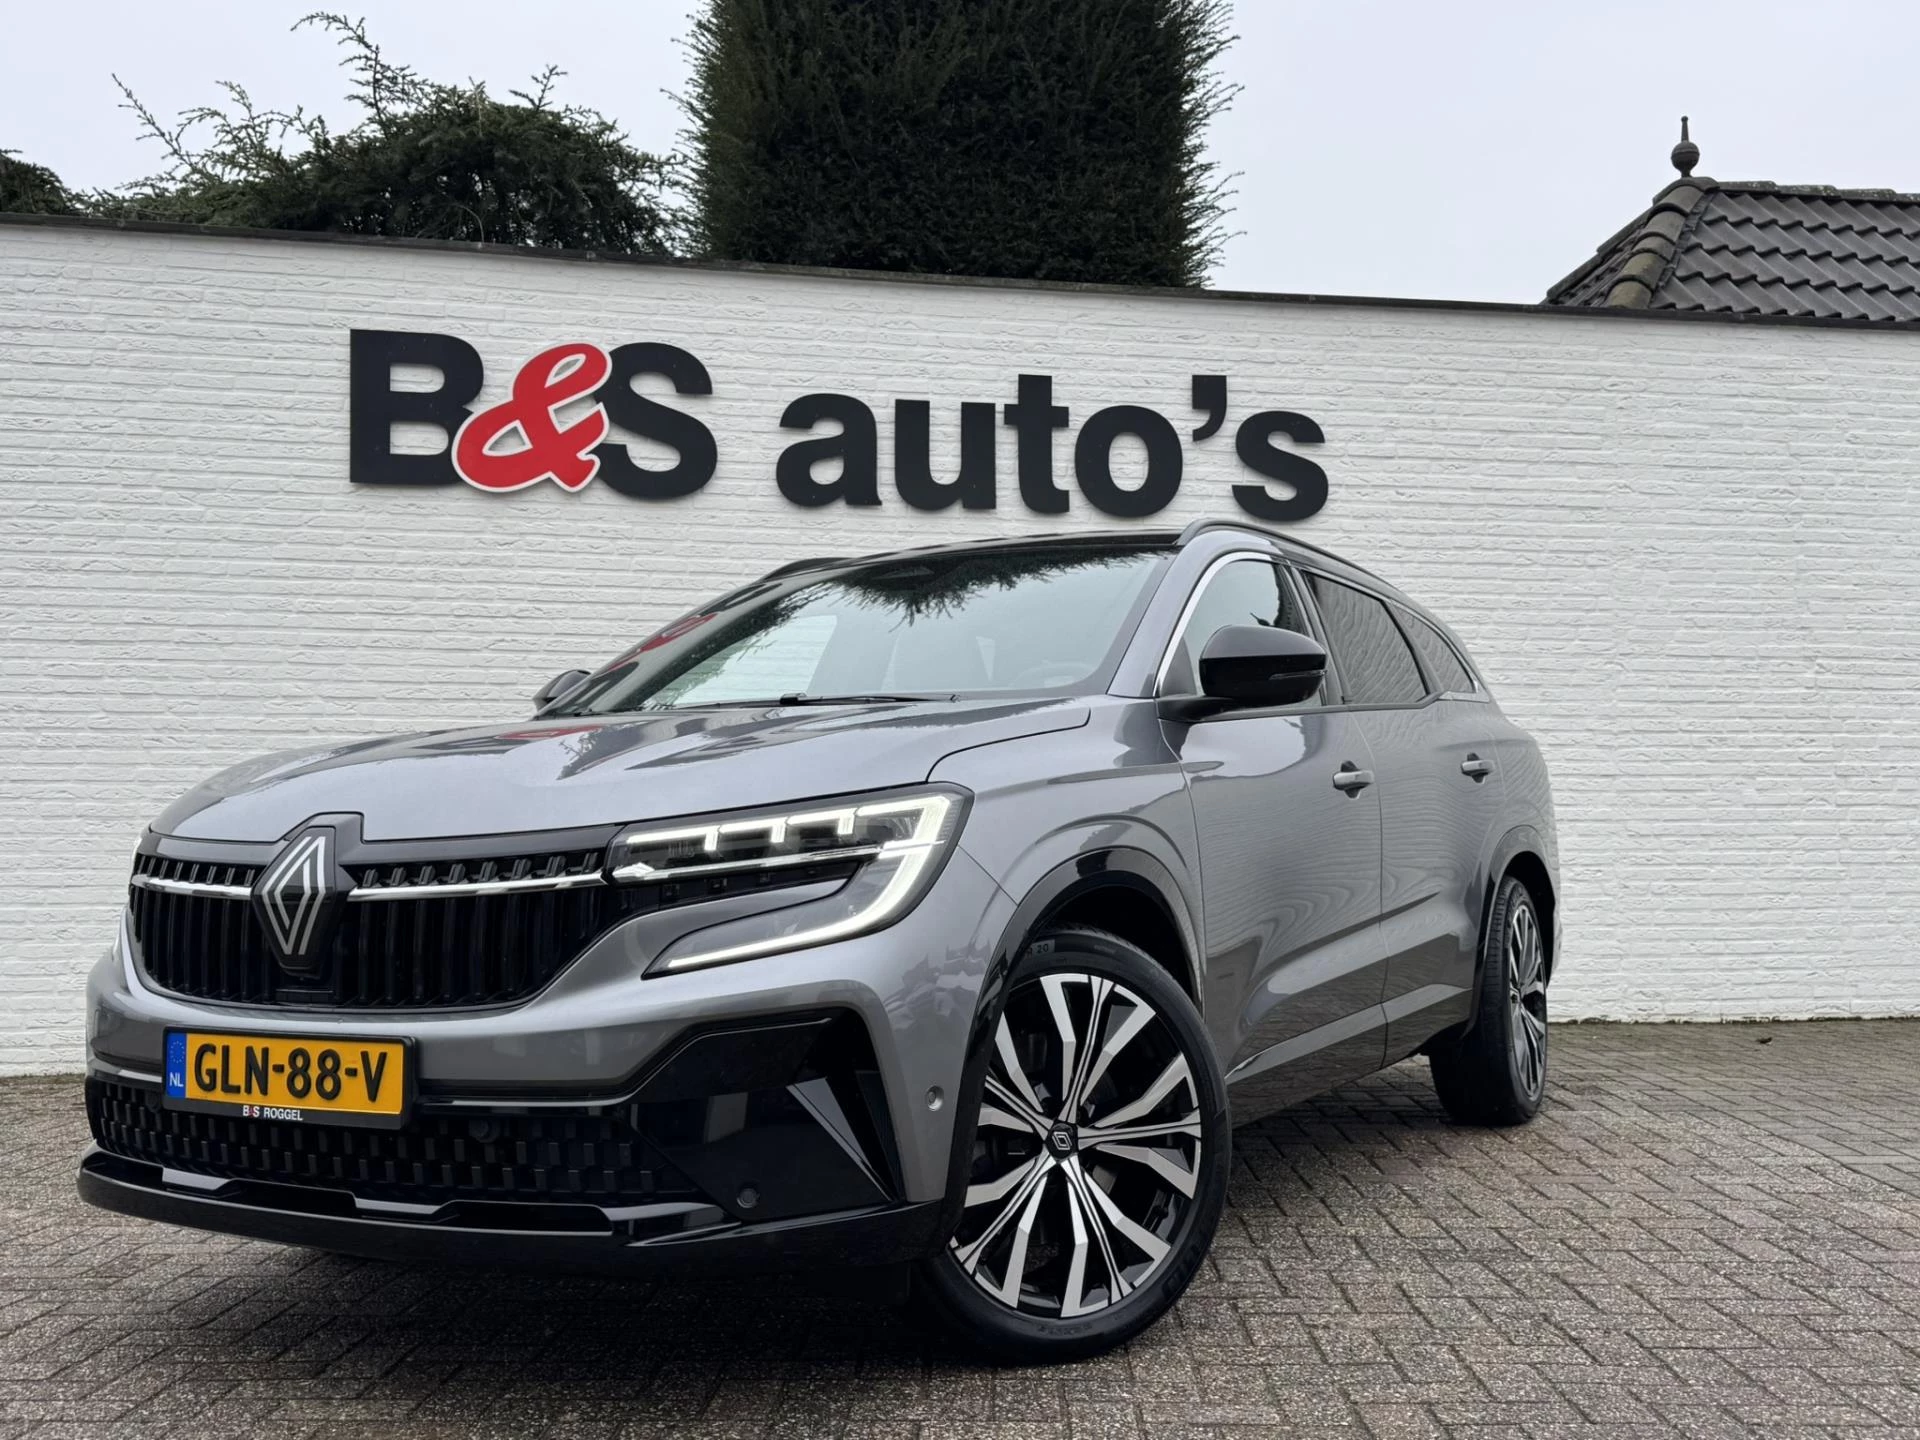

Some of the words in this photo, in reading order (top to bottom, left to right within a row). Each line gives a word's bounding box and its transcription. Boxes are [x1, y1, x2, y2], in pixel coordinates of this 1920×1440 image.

[350, 329, 717, 498] B&S
[776, 374, 1329, 521] auto's
[169, 1072, 184, 1088] NL
[194, 1043, 388, 1103] GLN-88-V
[263, 1107, 303, 1121] ROGGEL
